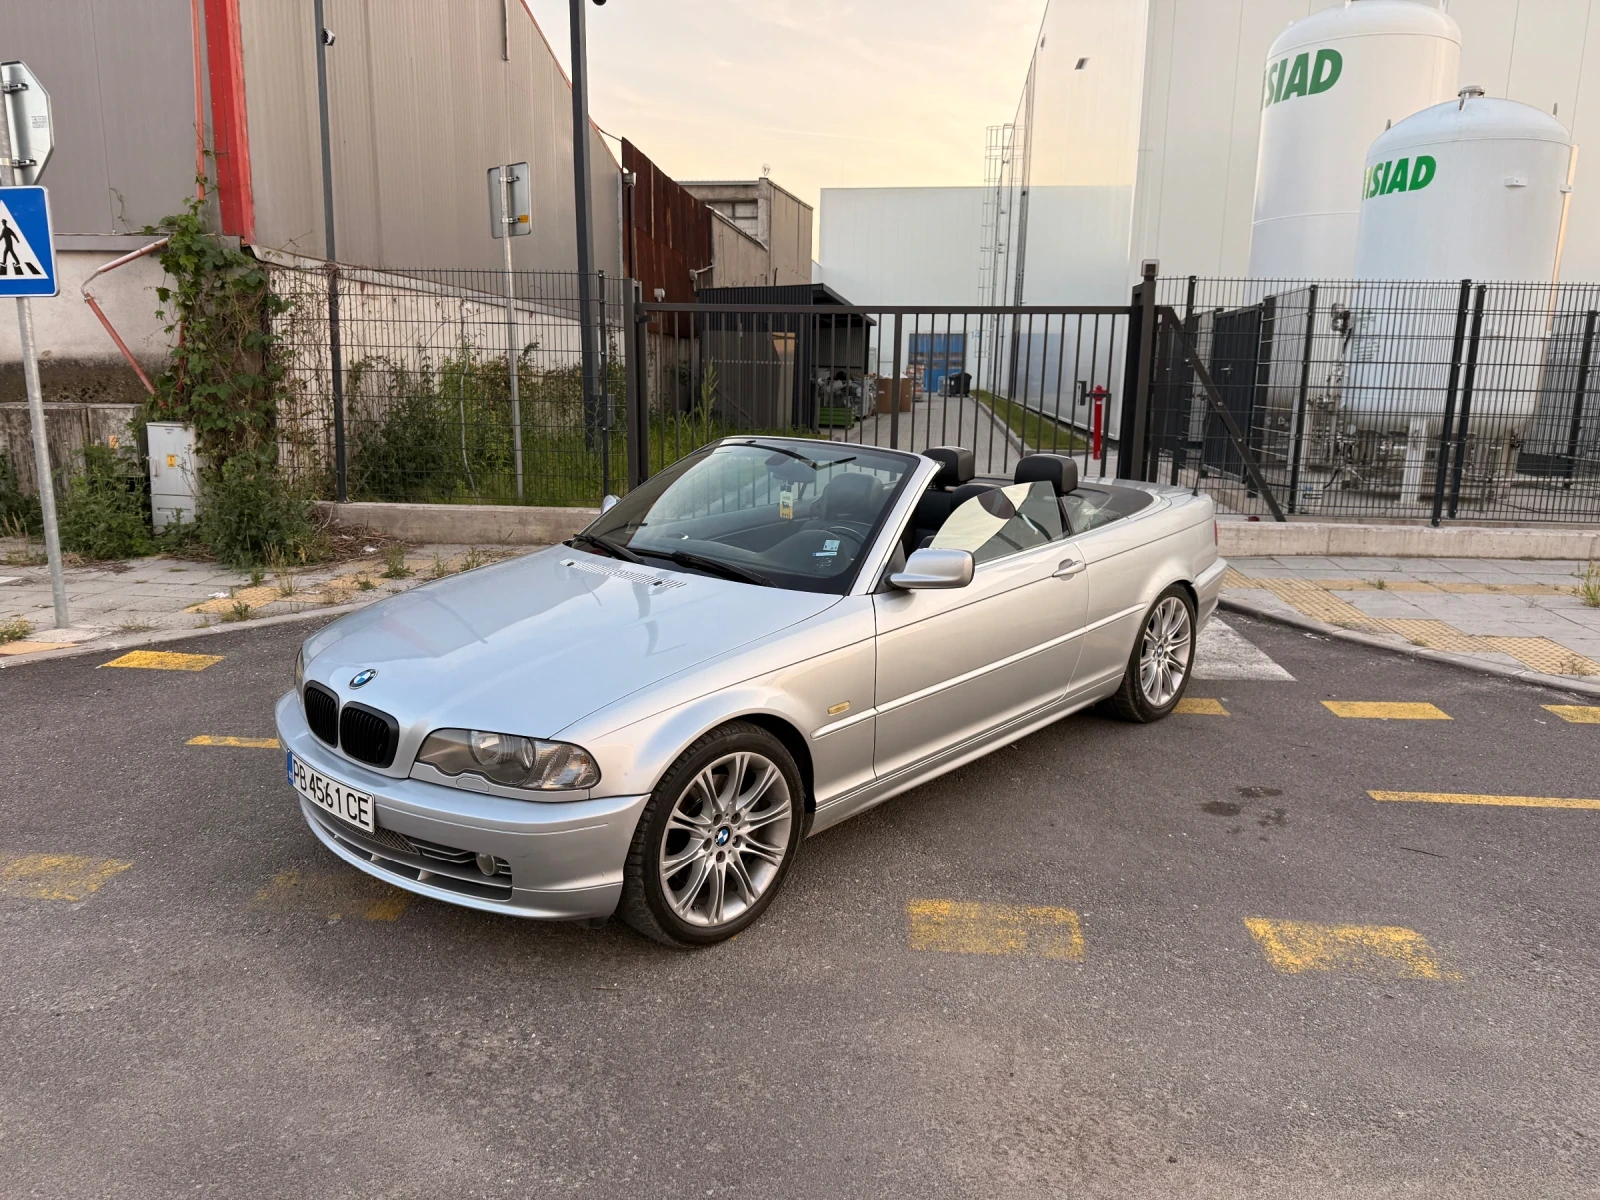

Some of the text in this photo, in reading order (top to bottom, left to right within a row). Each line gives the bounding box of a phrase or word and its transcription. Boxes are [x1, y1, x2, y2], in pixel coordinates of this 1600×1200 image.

[1265, 48, 1343, 108] SIAD
[1369, 155, 1436, 198] SIAD
[293, 759, 370, 827] PB 4561 CE
